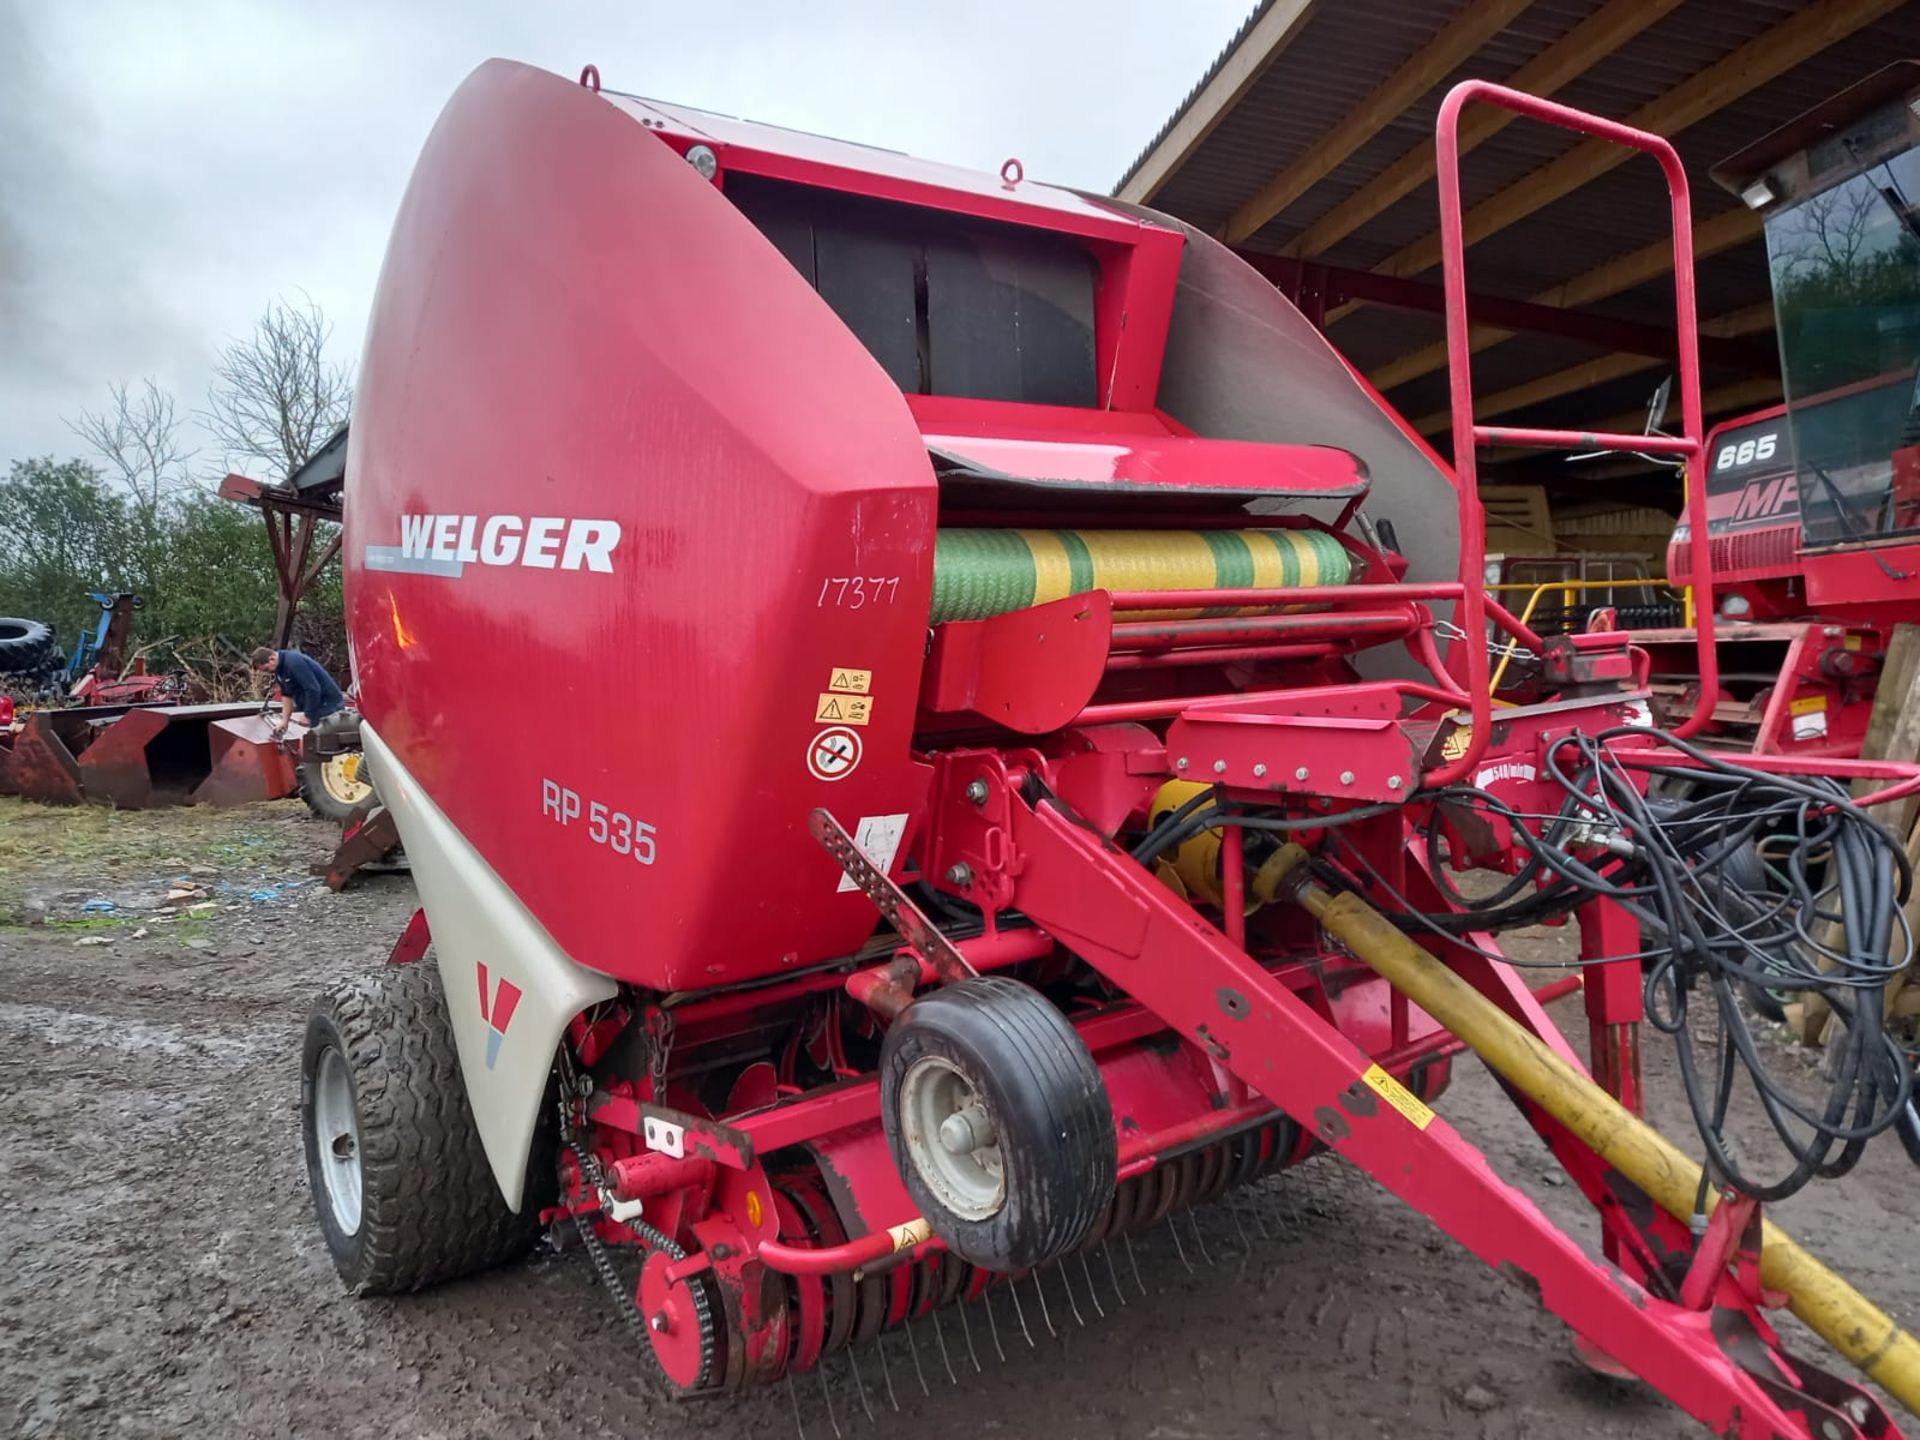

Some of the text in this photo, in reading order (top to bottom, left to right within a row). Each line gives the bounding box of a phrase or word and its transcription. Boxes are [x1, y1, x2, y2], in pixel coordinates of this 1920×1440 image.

[1717, 433, 1778, 470] 665
[401, 514, 621, 574] WELGER
[543, 778, 657, 865] RP 535
